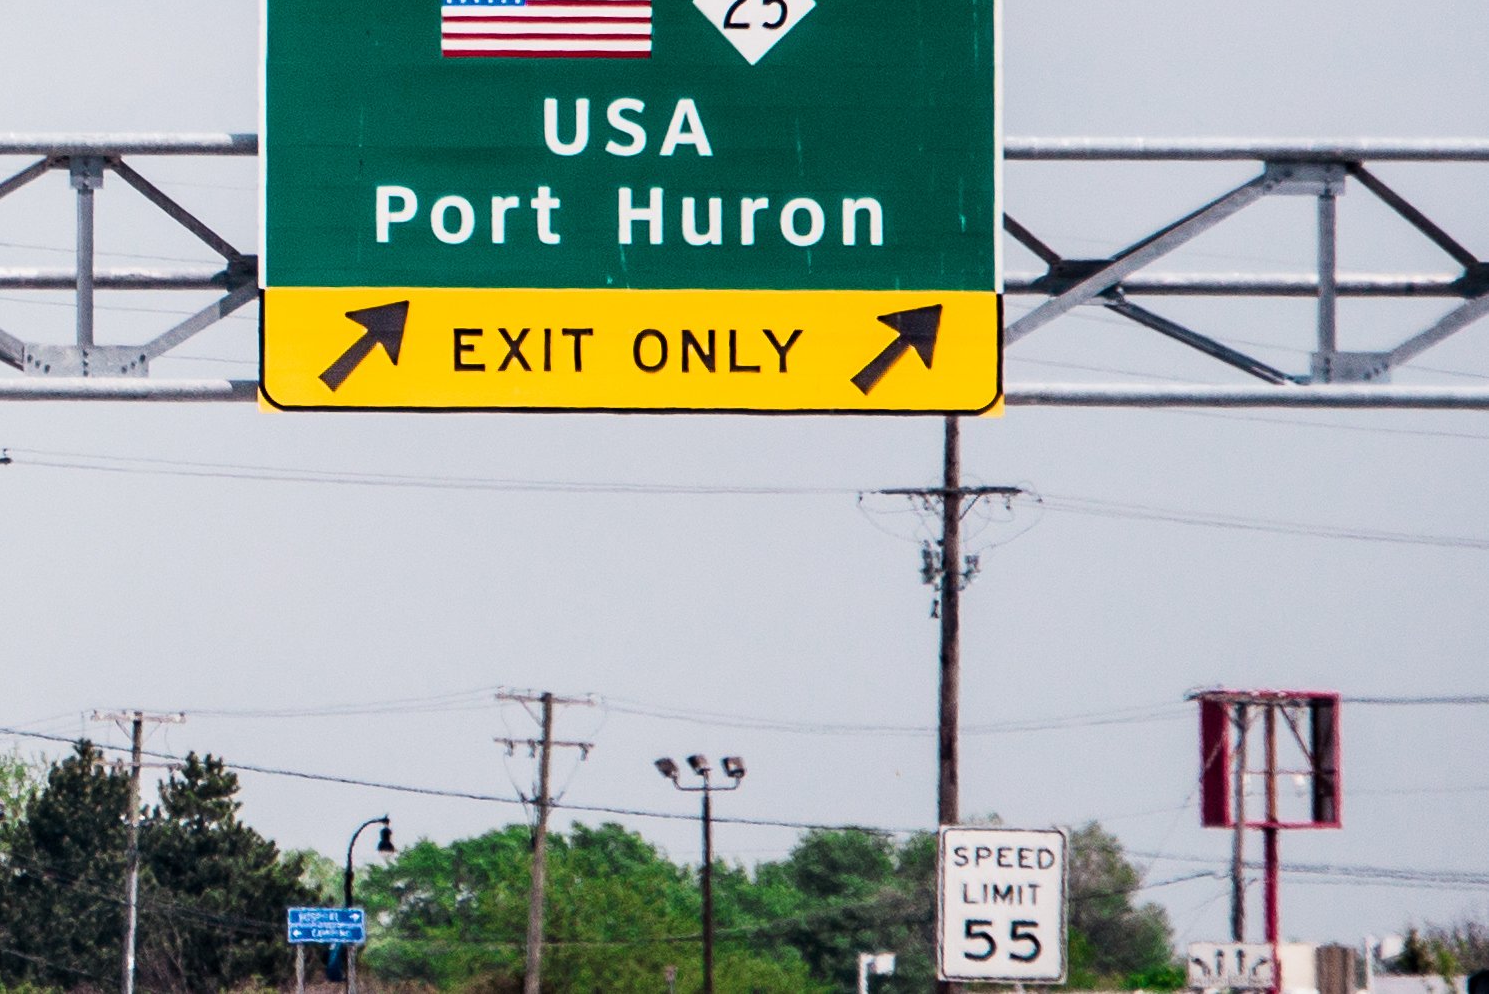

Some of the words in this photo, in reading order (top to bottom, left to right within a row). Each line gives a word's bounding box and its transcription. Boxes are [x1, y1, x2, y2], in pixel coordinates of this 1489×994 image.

[544, 97, 712, 157] USA
[375, 186, 561, 245] Port
[618, 188, 883, 247] Huron
[454, 328, 594, 372] EXIT
[633, 329, 803, 373] ONLY
[953, 846, 1055, 869] SPEED
[962, 883, 1040, 905] LIMIT
[963, 919, 1042, 963] 55
